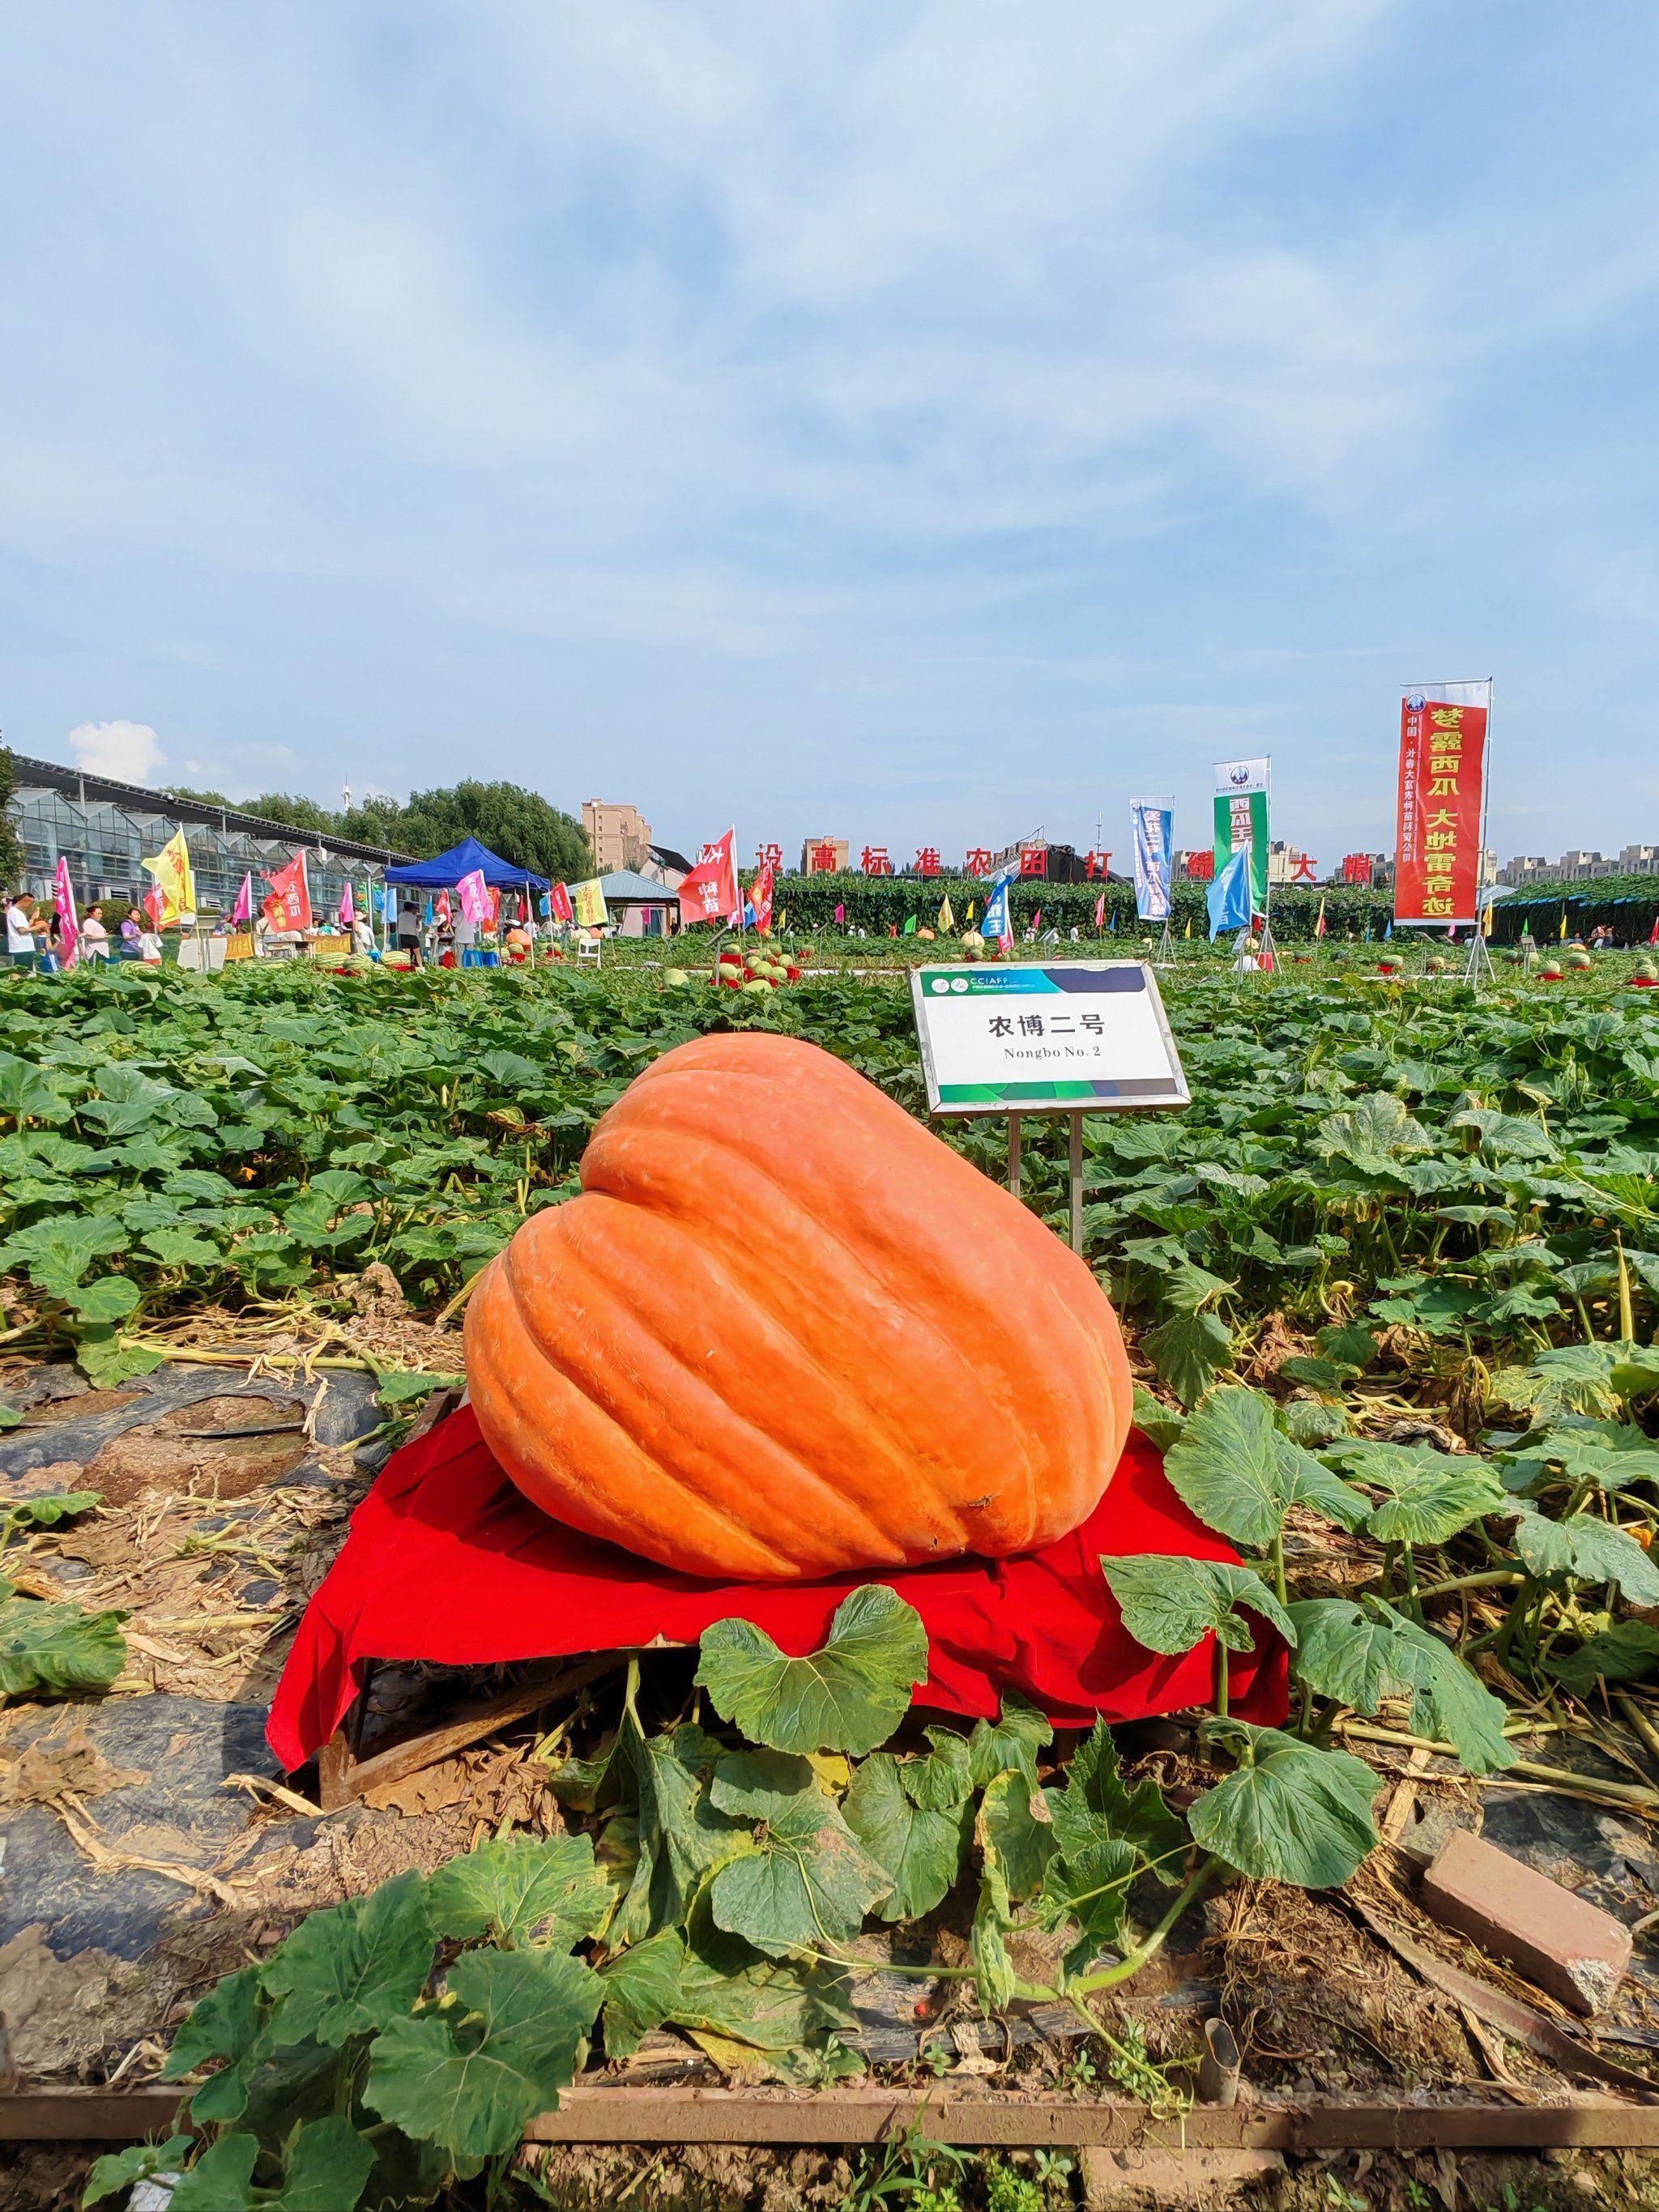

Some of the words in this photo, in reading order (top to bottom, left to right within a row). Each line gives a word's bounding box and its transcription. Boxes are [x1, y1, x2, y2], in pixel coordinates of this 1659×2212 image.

[988, 1012, 1105, 1038] 农博二号
[1004, 1046, 1061, 1060] Nongbo
